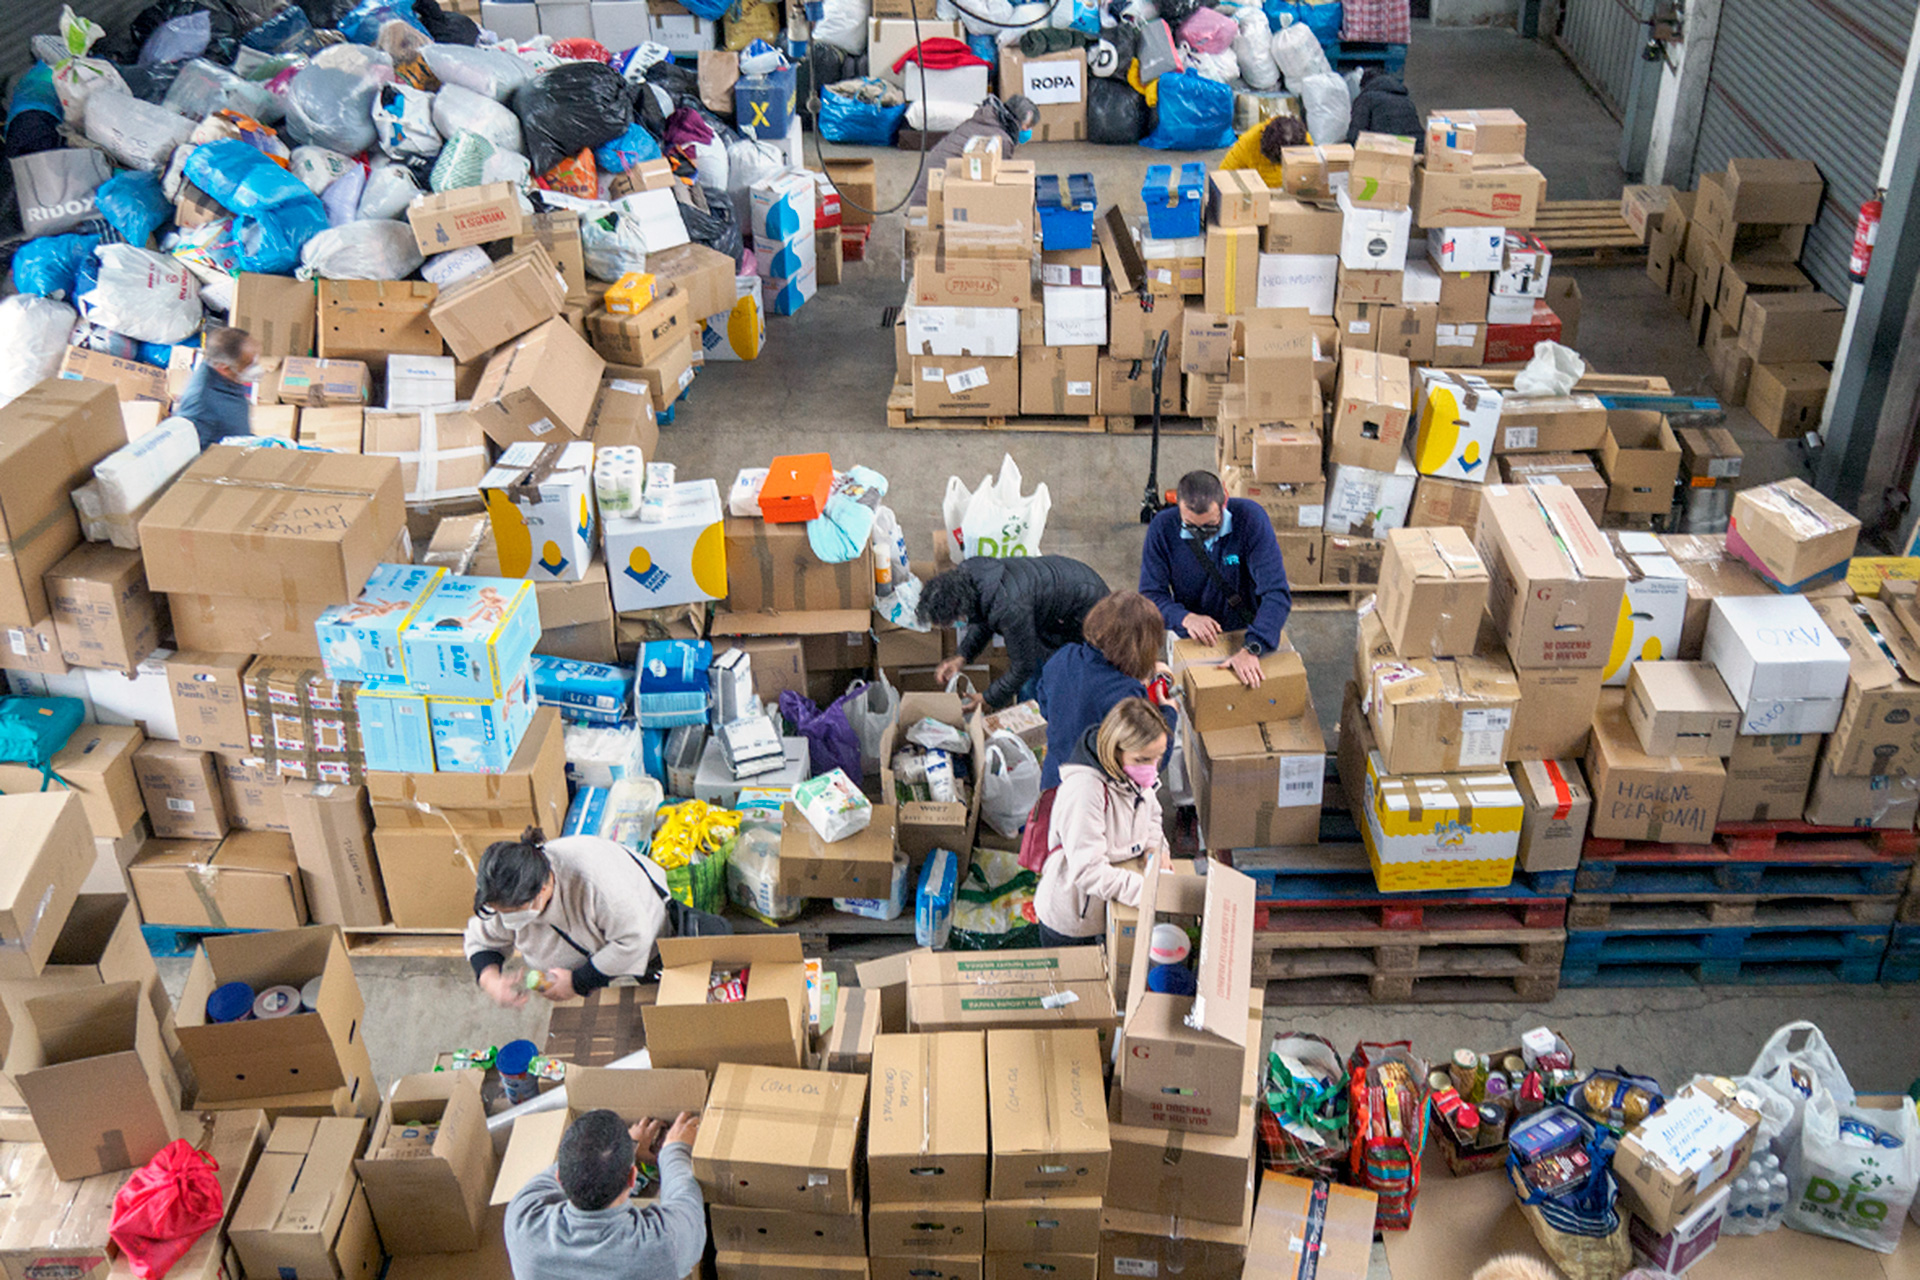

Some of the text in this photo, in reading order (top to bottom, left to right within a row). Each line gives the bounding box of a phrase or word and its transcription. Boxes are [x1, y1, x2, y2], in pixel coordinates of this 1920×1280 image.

[1031, 76, 1075, 90] ROPA
[750, 101, 770, 127] X
[1537, 588, 1552, 600] G
[450, 645, 469, 678] BABY
[1748, 703, 1785, 733] ASEO
[1618, 781, 1695, 802] HIGIENE
[1132, 1046, 1149, 1059] G
[761, 1077, 820, 1095] COMIDA
[1151, 1102, 1212, 1116] 30 DOCENAS
[1153, 1113, 1166, 1122] DE
[1804, 1175, 1888, 1222] Dia
